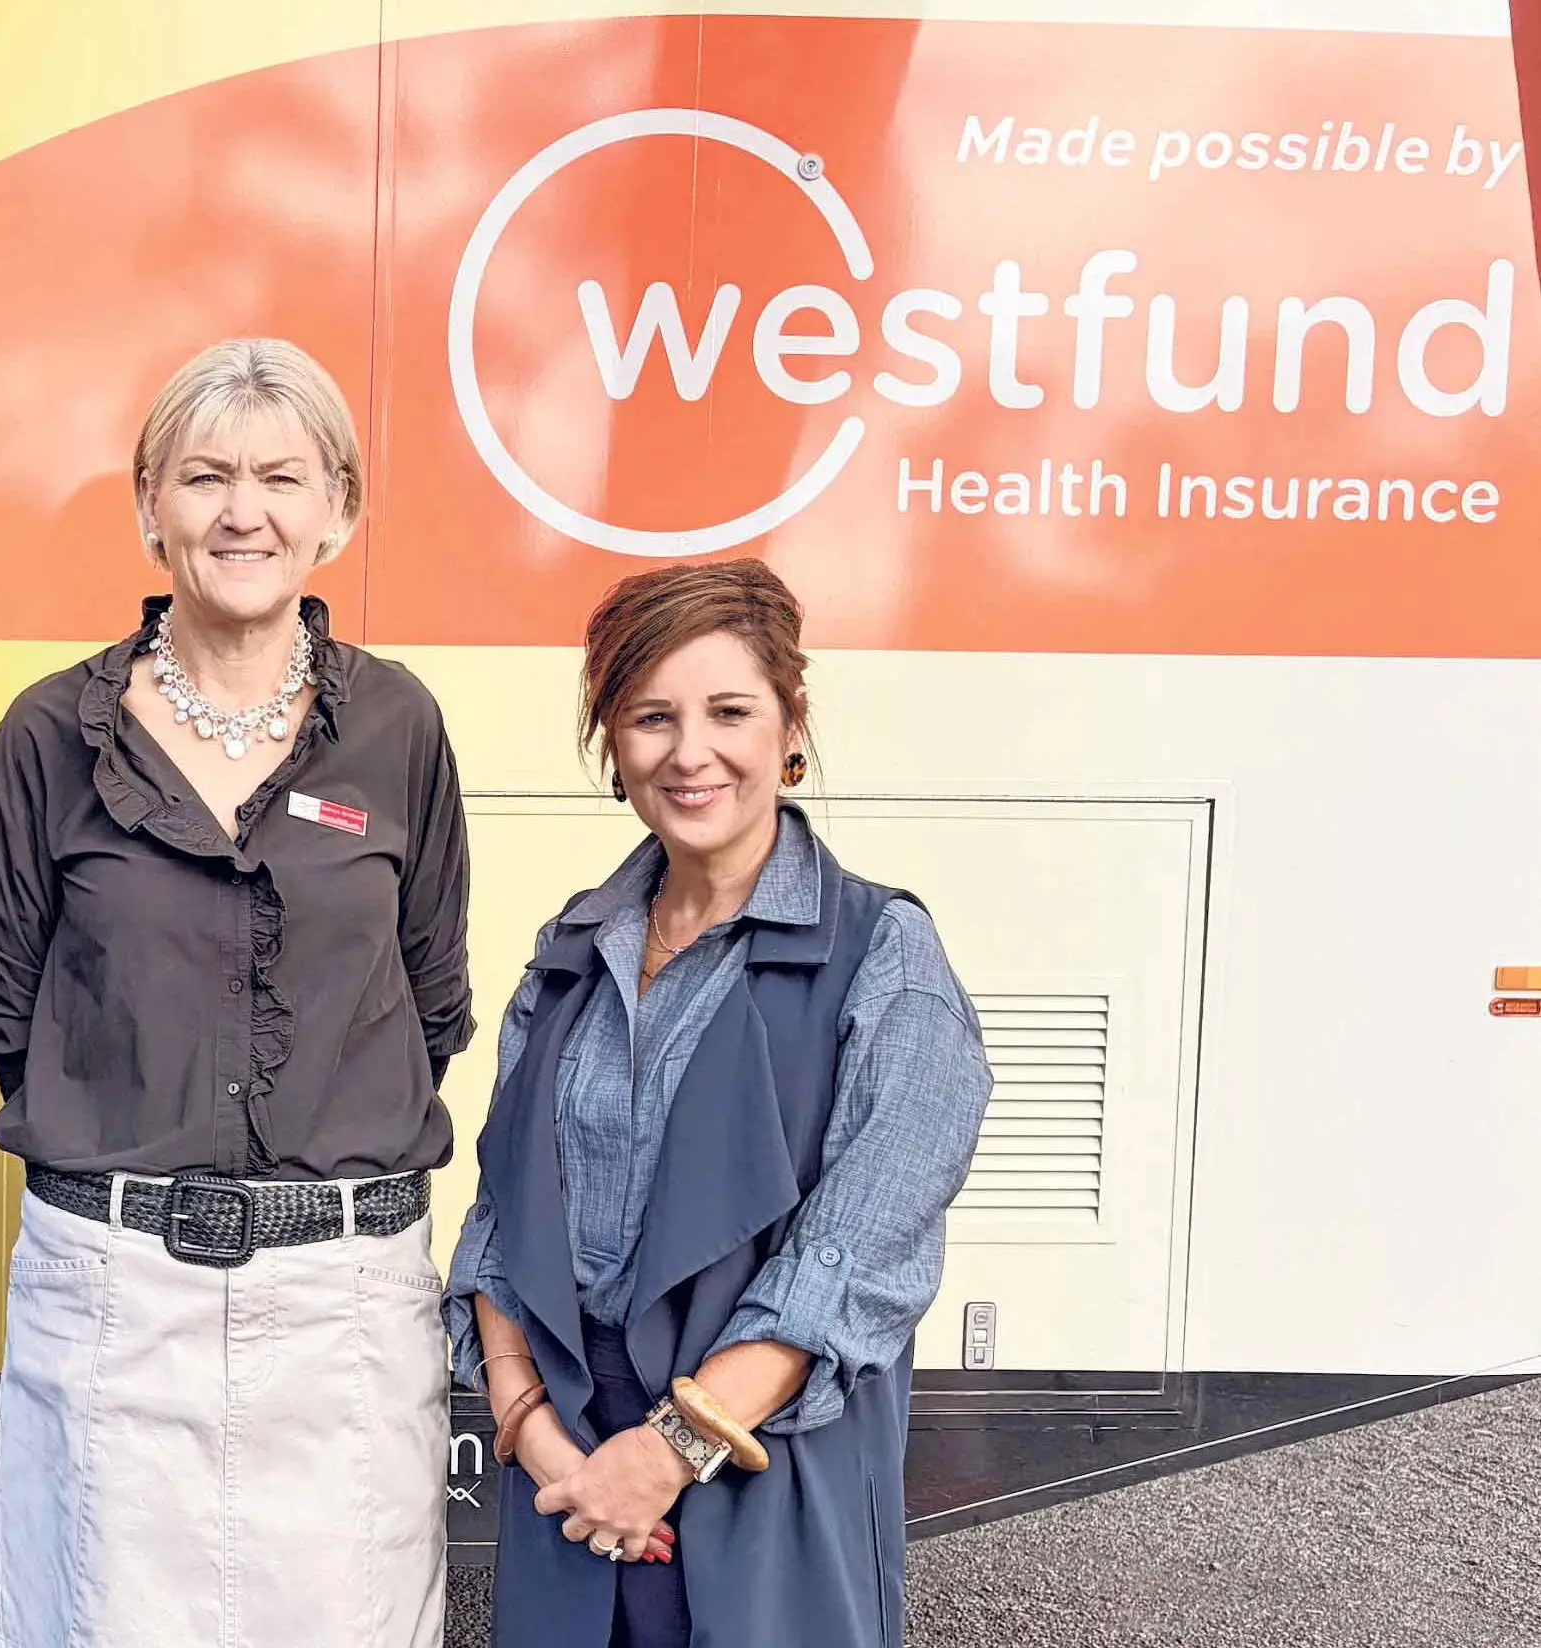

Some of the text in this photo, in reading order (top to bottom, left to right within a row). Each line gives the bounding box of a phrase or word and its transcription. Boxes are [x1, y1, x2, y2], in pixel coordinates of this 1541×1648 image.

[956, 114, 1523, 190] Made possible by
[576, 248, 1516, 418] westfund
[896, 457, 1501, 524] Health Insurance
